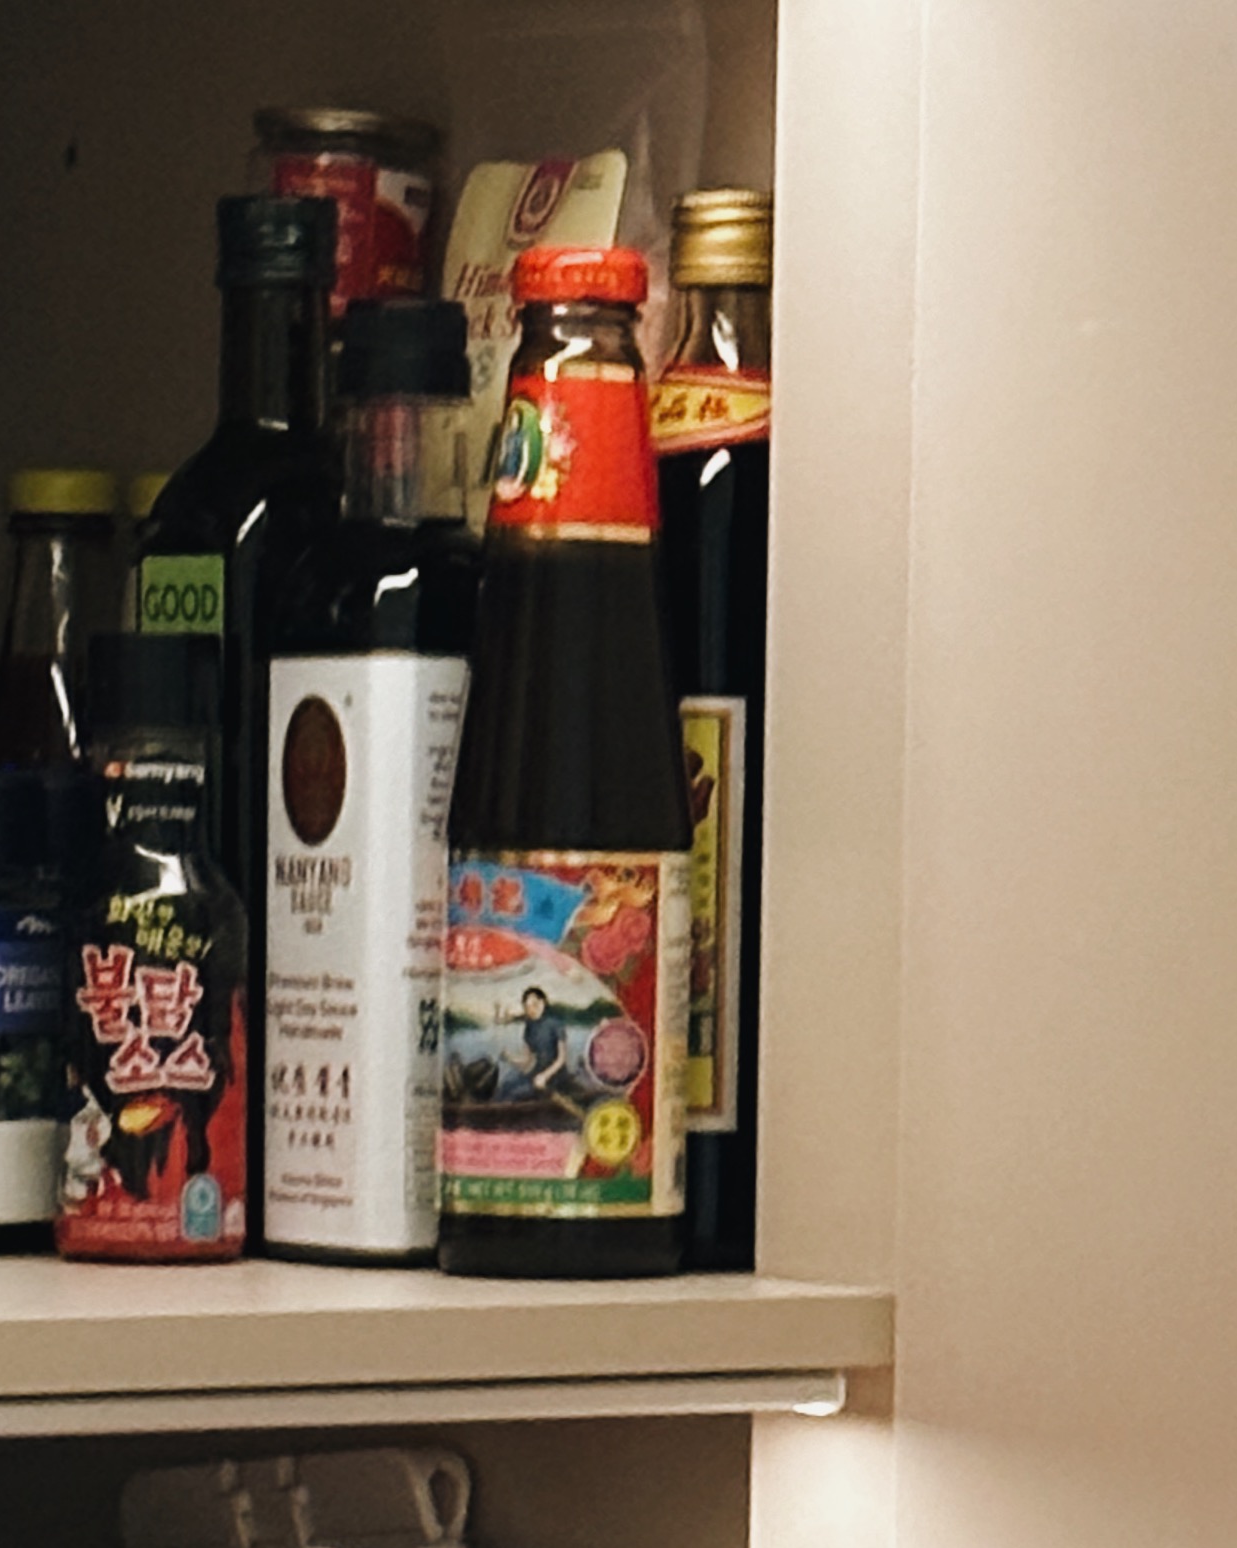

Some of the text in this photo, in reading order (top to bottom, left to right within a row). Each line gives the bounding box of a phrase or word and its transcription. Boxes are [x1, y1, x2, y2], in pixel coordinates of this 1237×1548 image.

[145, 584, 218, 622] GOOD
[76, 944, 205, 1044] 불닭
[105, 1027, 216, 1094] 소스
